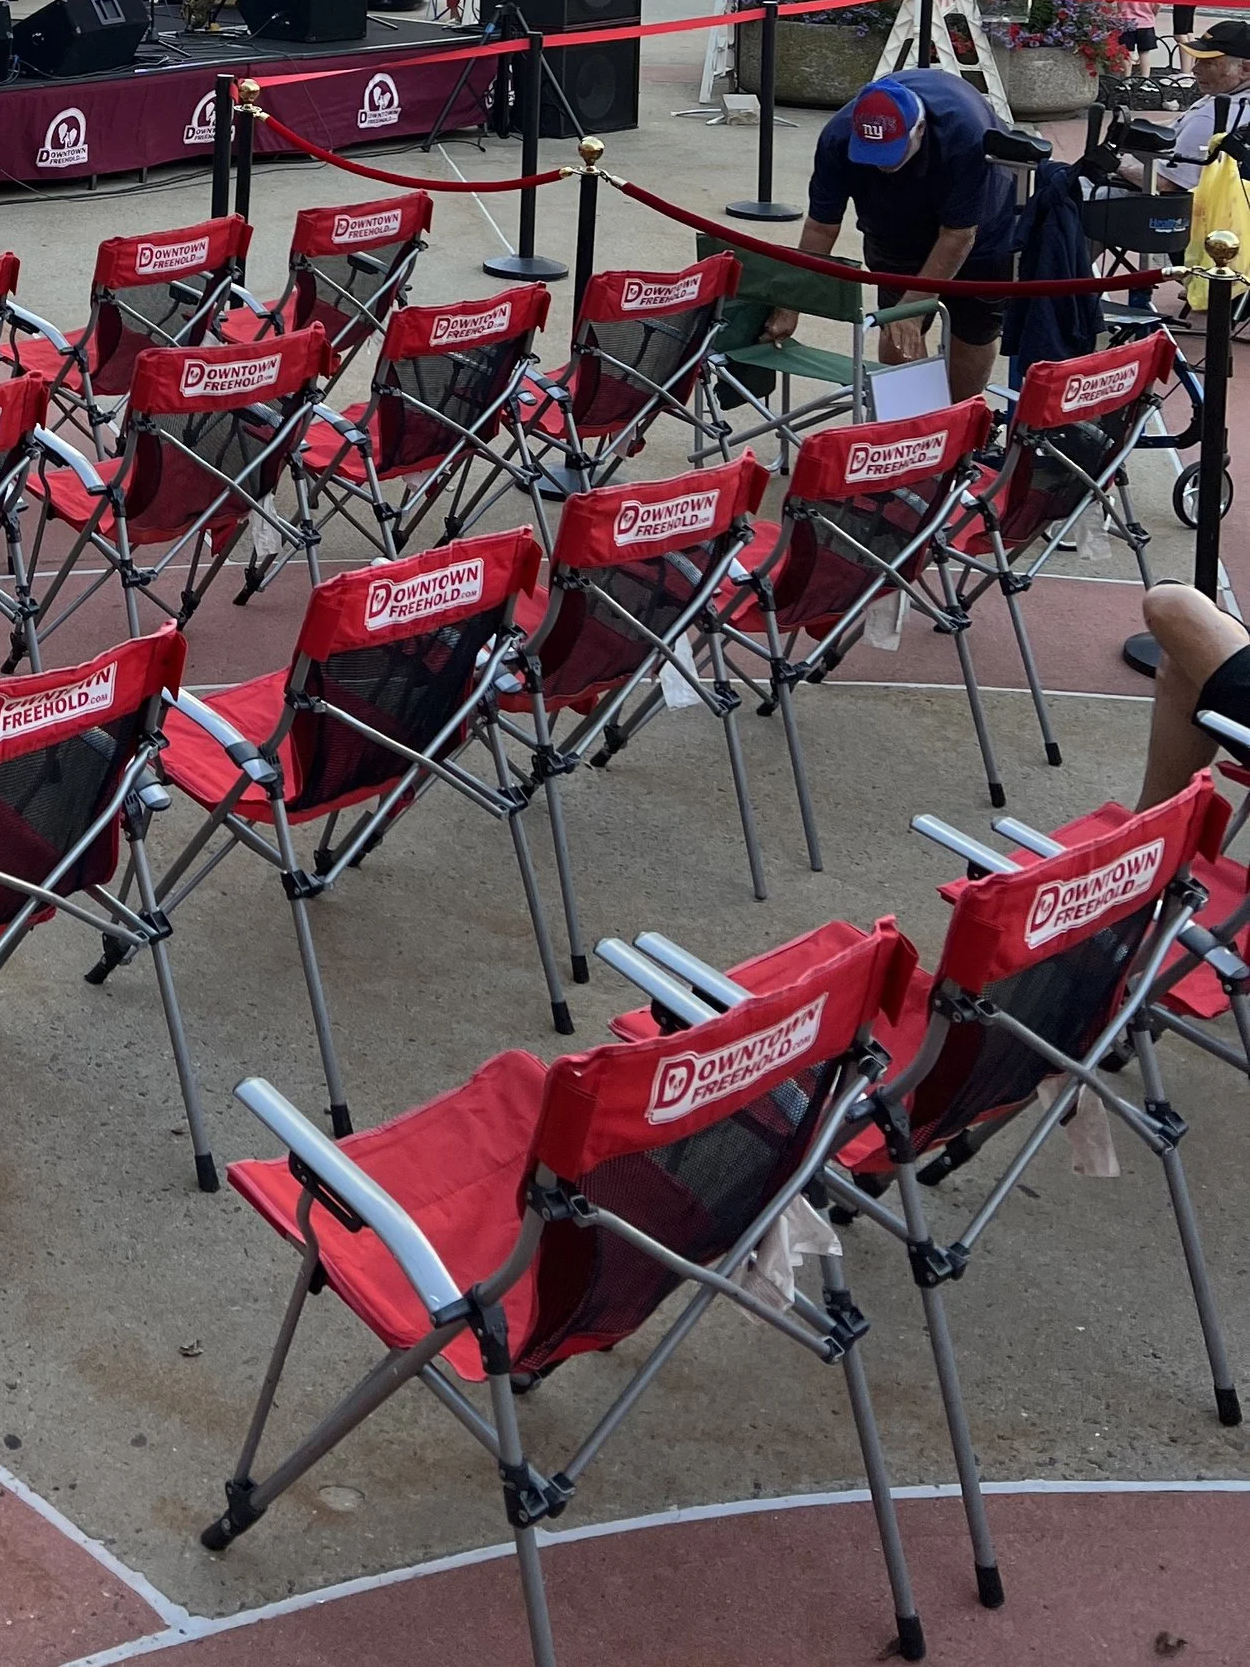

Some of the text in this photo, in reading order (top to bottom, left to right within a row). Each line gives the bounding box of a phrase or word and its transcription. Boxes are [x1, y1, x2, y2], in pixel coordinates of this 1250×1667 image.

[39, 148, 86, 163] DOWNTOWN
[334, 213, 399, 237] DOWNTOWN
[139, 241, 206, 268] DOWNTOWN
[628, 277, 699, 303] DOWNTOWN
[433, 306, 507, 339] DOWNTOWN
[184, 358, 277, 388] DOWNTOWN
[1064, 367, 1136, 403] DOWNTOWN
[851, 436, 944, 472] DOWNTOWN
[618, 494, 715, 532] DOWNTOWN
[368, 565, 479, 618] DOWNTOWN
[1030, 848, 1158, 933] DOWNTOWN
[654, 1007, 820, 1110] DOWNTOWN
